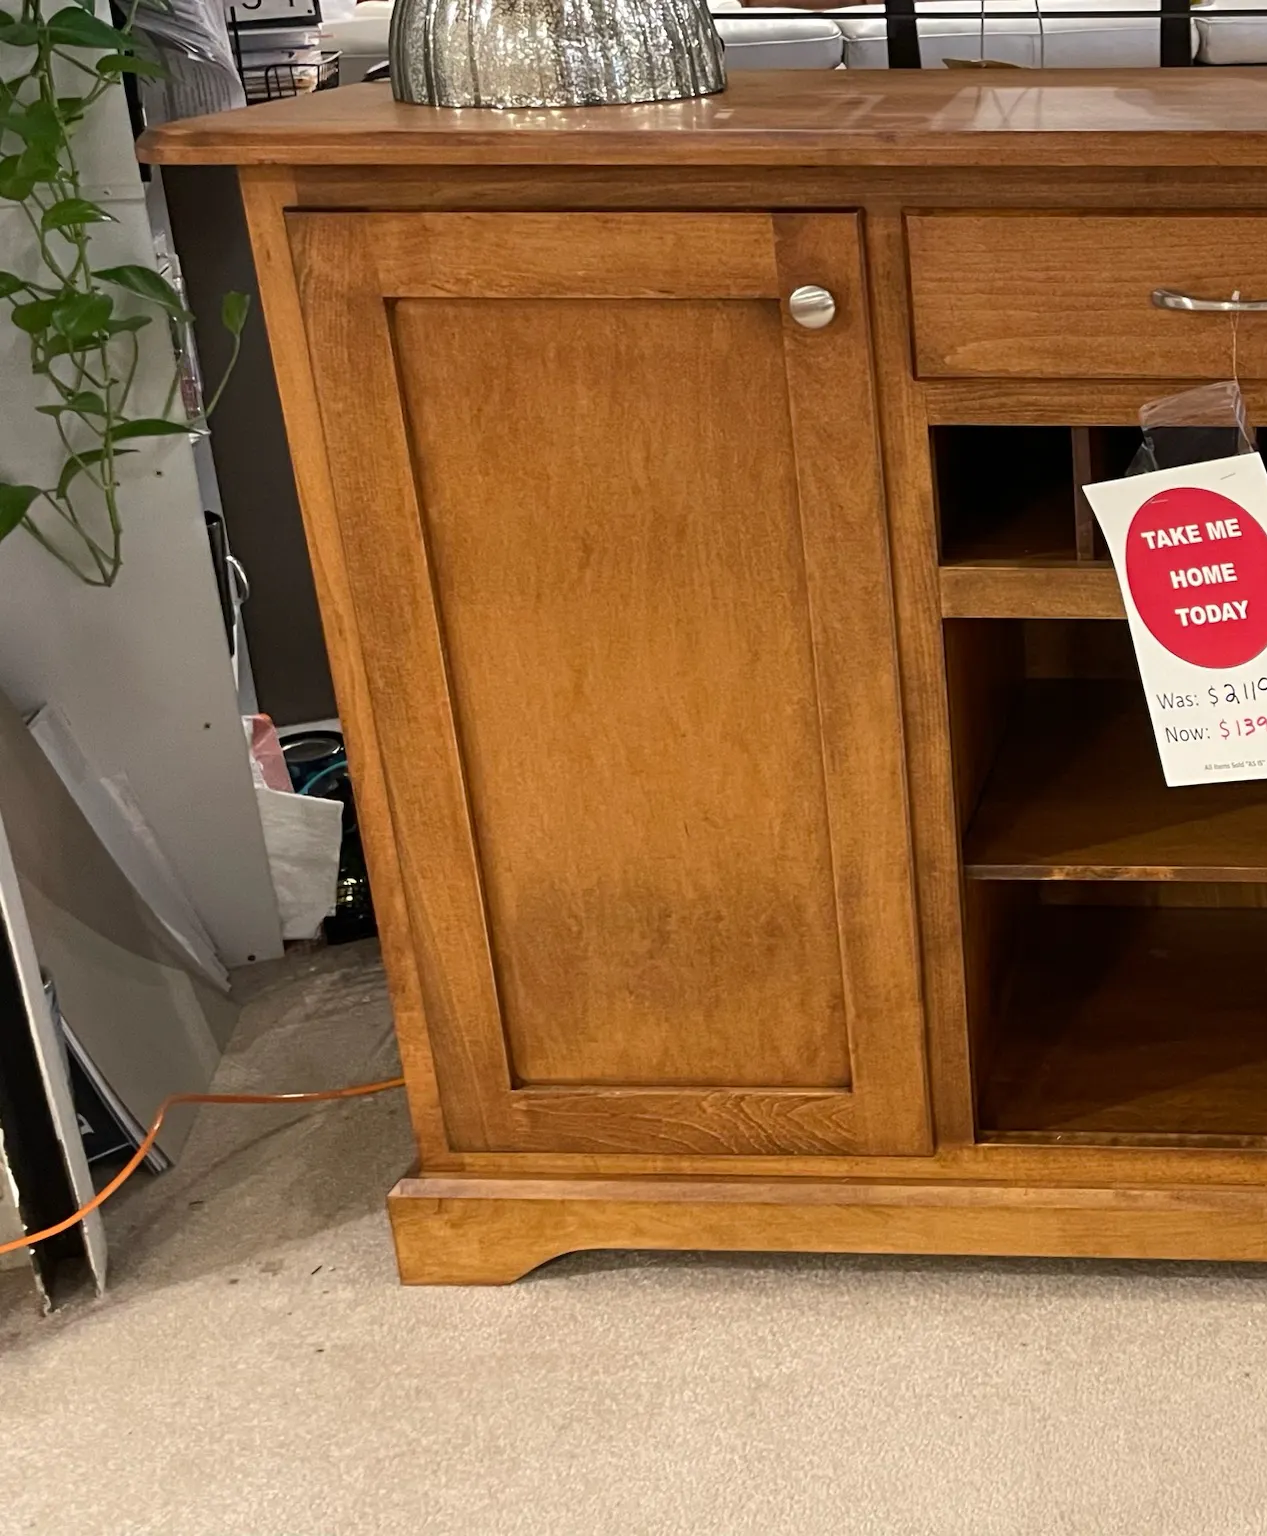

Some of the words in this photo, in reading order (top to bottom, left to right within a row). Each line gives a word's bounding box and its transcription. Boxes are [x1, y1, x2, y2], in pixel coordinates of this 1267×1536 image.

[1140, 524, 1204, 550] TAKE
[1205, 518, 1243, 541] ME
[1169, 562, 1238, 589] HOME
[1174, 600, 1248, 627] TODAY
[1156, 692, 1200, 710] Was:
[1165, 727, 1211, 743] Now:
[1231, 761, 1245, 769] Sold
